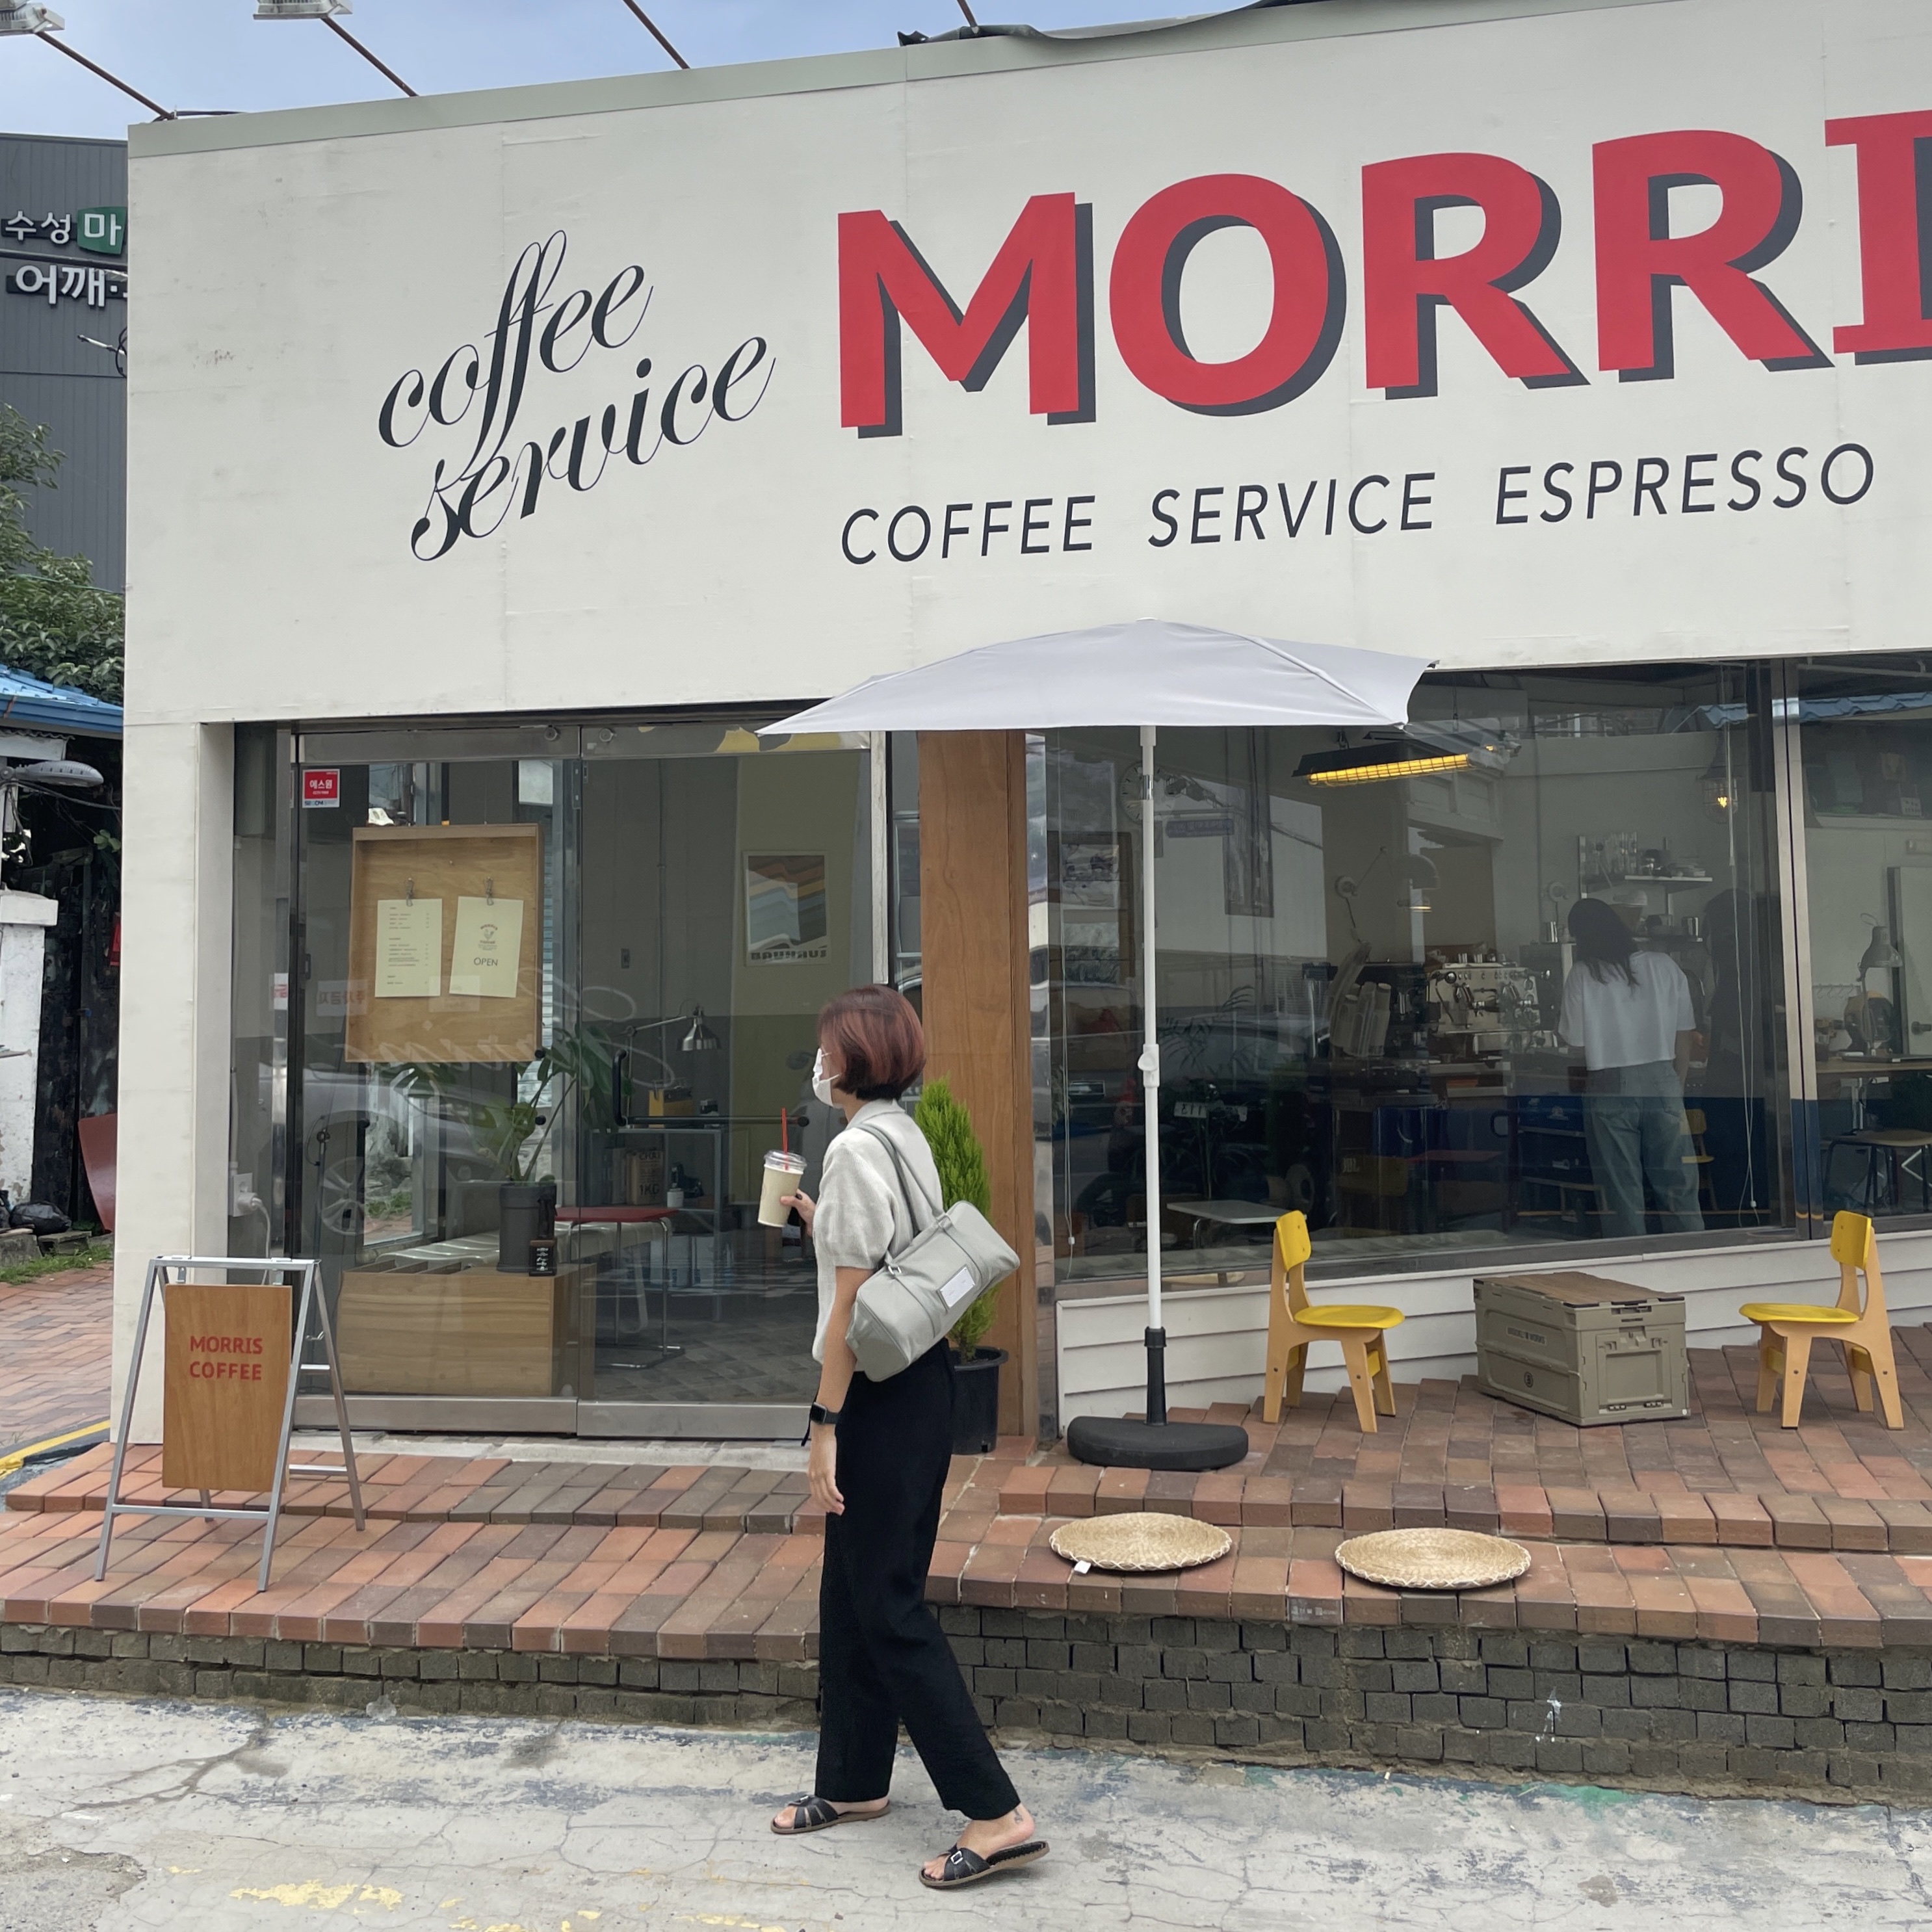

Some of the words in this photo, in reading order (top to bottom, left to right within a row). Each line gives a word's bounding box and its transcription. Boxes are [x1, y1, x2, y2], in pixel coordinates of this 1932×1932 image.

[378, 229, 654, 493] coffee
[410, 336, 776, 562] service
[841, 495, 1096, 565] COFFEE
[1148, 472, 1436, 548] SERVICE
[1495, 443, 1874, 525] ESPRESSO
[473, 957, 499, 967] OPEN
[190, 1335, 263, 1355] MORRIS
[190, 1361, 262, 1380] COFFEE
